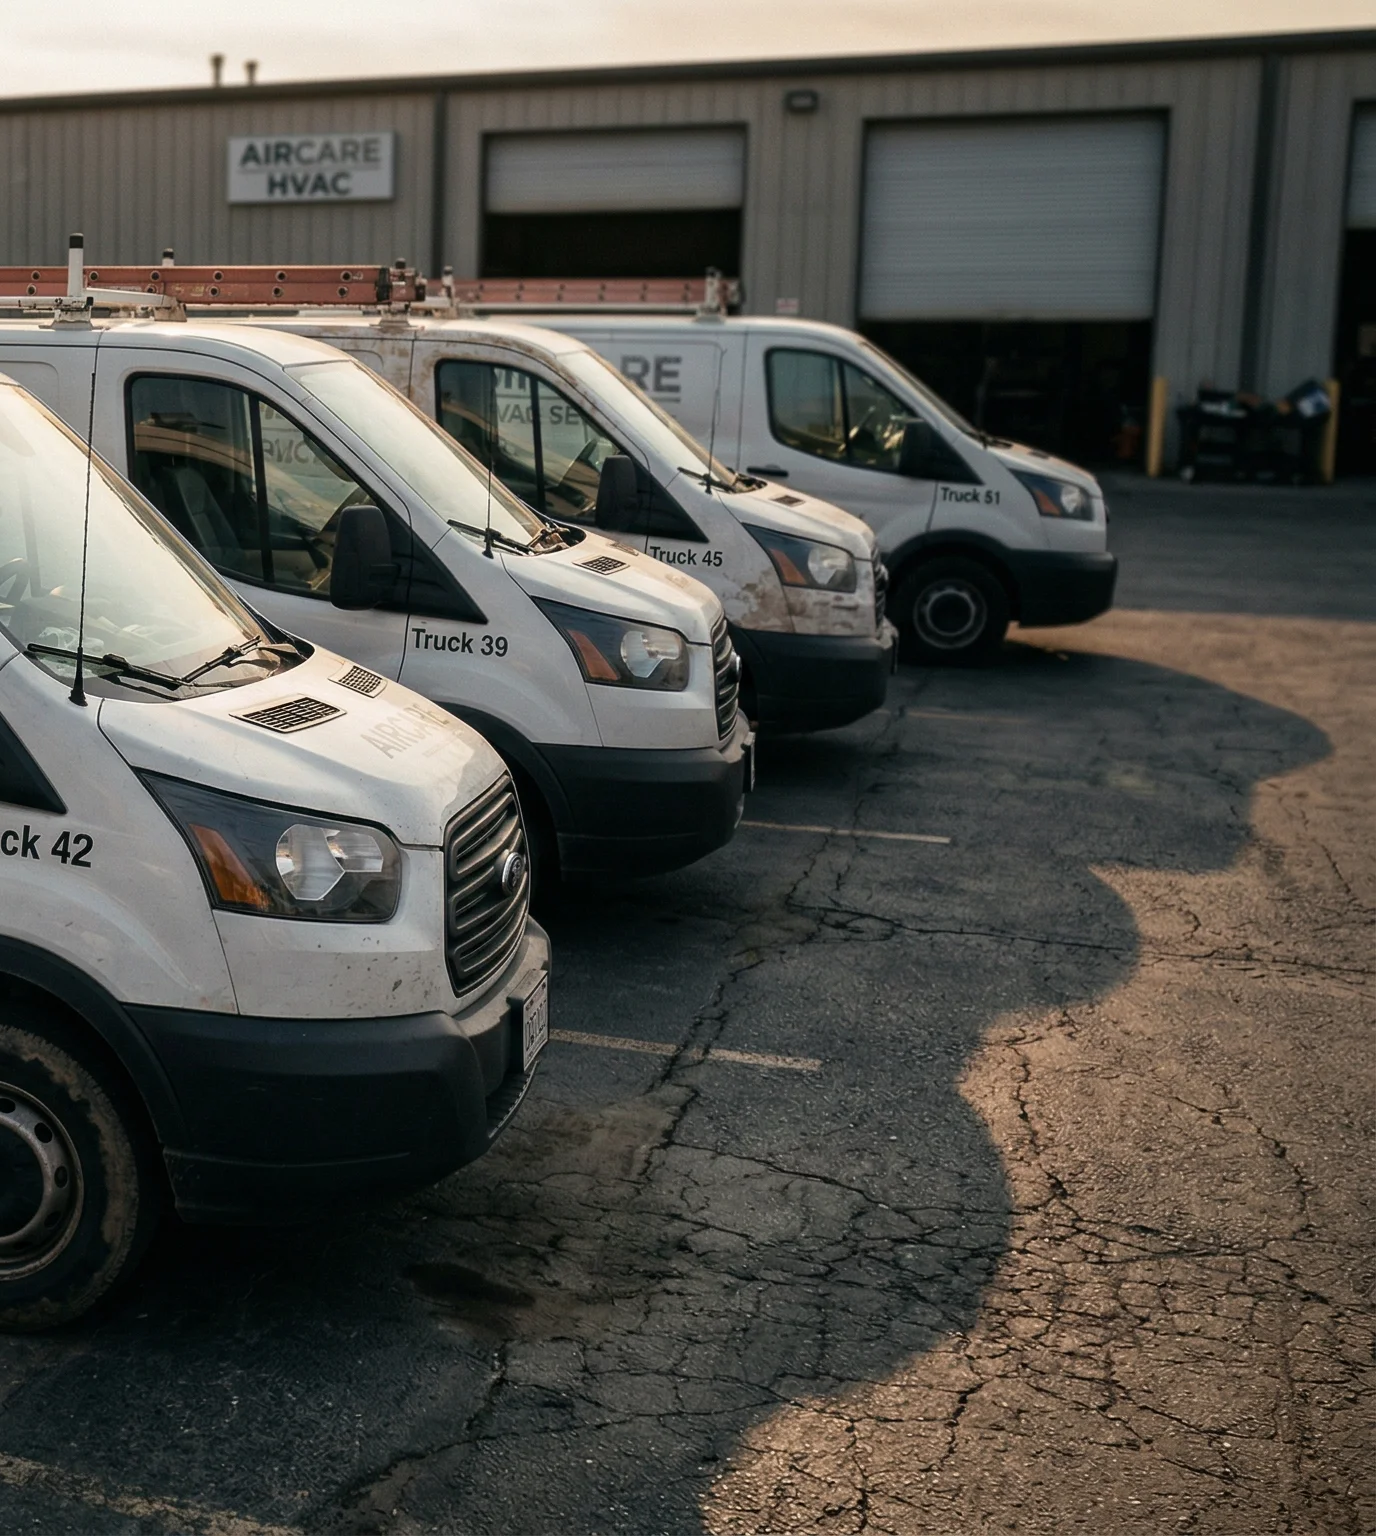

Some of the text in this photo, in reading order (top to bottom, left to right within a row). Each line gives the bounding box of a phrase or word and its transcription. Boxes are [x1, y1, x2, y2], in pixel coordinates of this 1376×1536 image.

[240, 137, 381, 167] AIRCARE
[267, 171, 352, 197] HVAC
[940, 486, 1001, 505] Truck 51
[649, 545, 723, 567] Truck 45
[411, 627, 509, 658] Truck 39
[50, 830, 95, 869] 42
